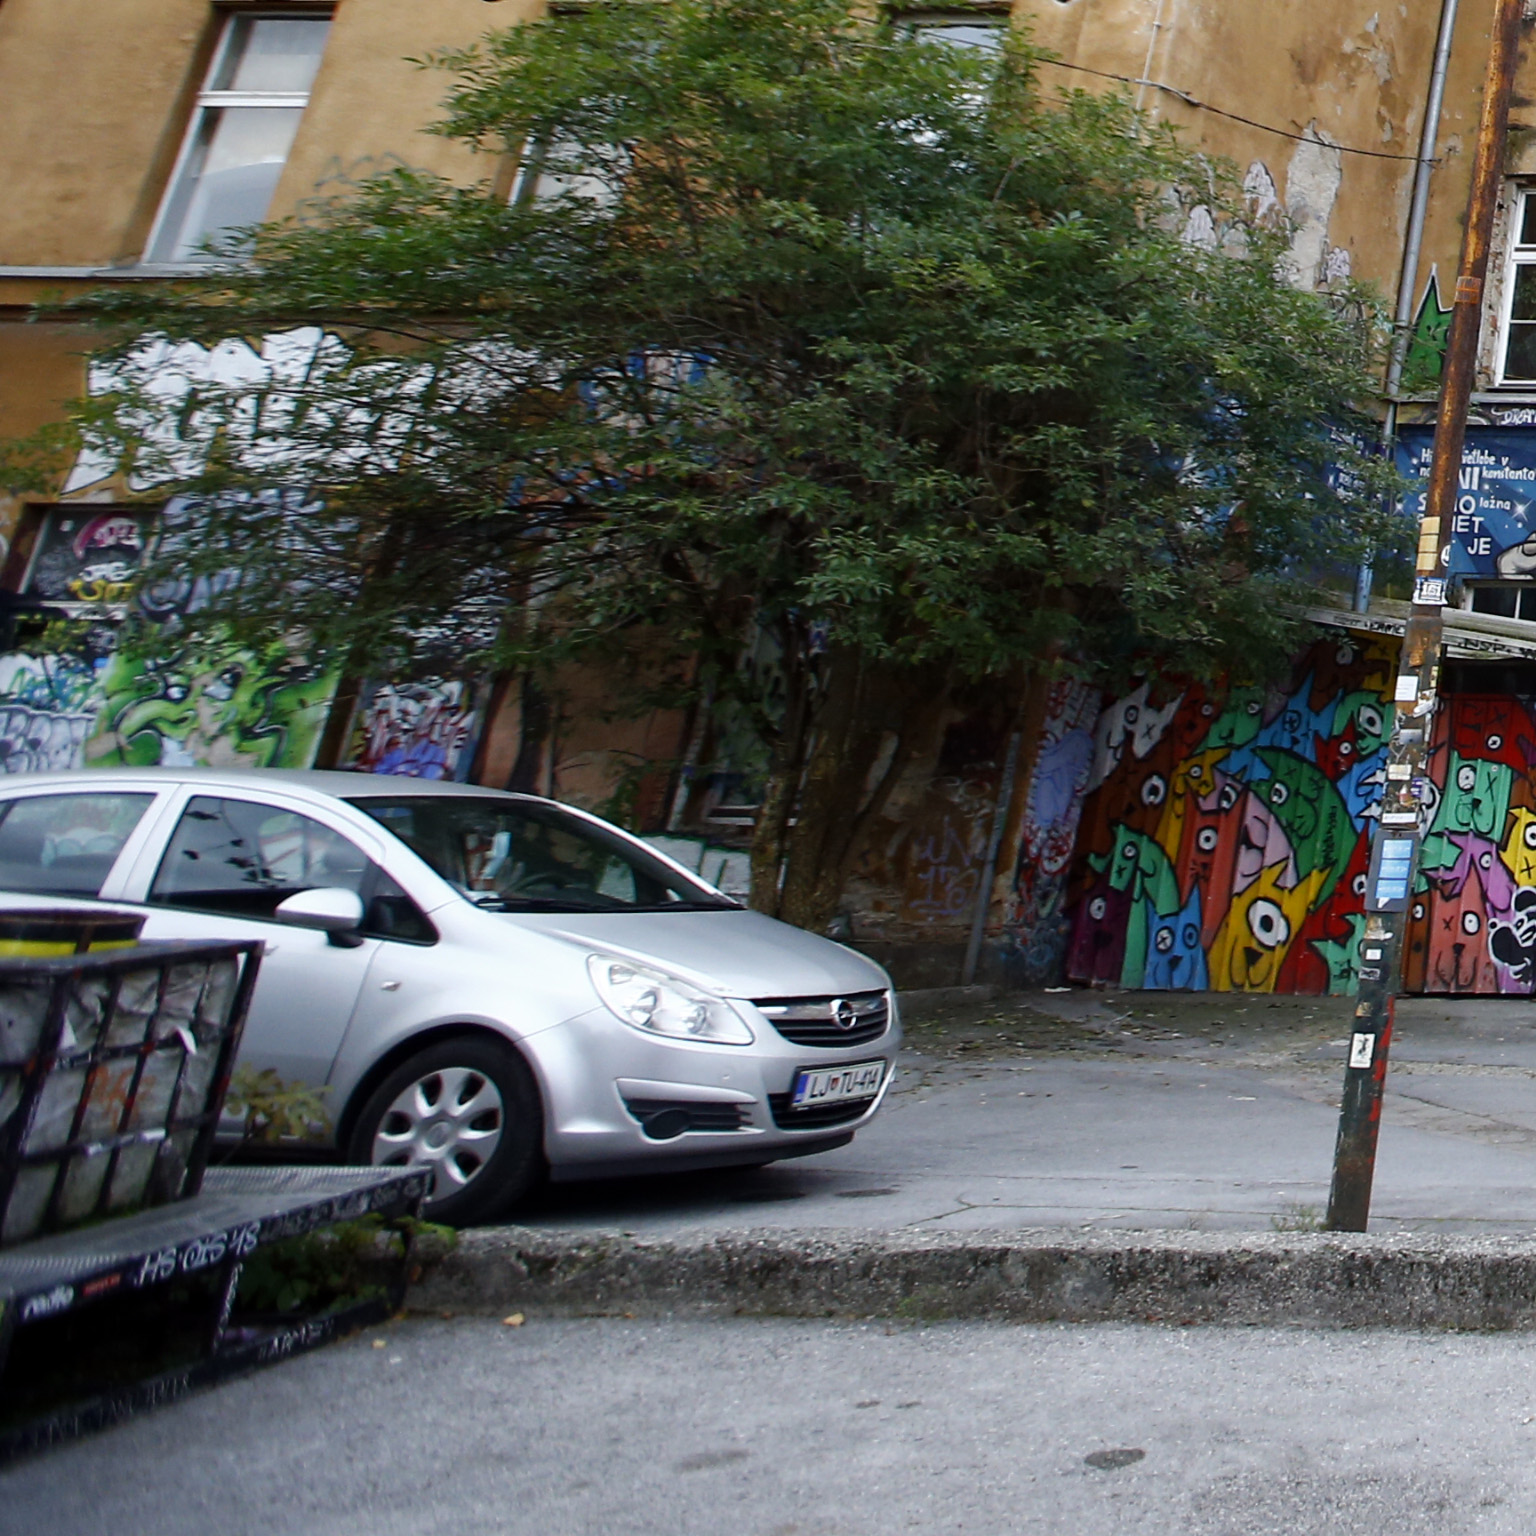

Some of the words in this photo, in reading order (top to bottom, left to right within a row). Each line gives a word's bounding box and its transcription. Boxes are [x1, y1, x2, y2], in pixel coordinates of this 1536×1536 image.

[1461, 448, 1496, 465] vetlobe
[1467, 538, 1492, 555] JE
[809, 1075, 832, 1098] LJ
